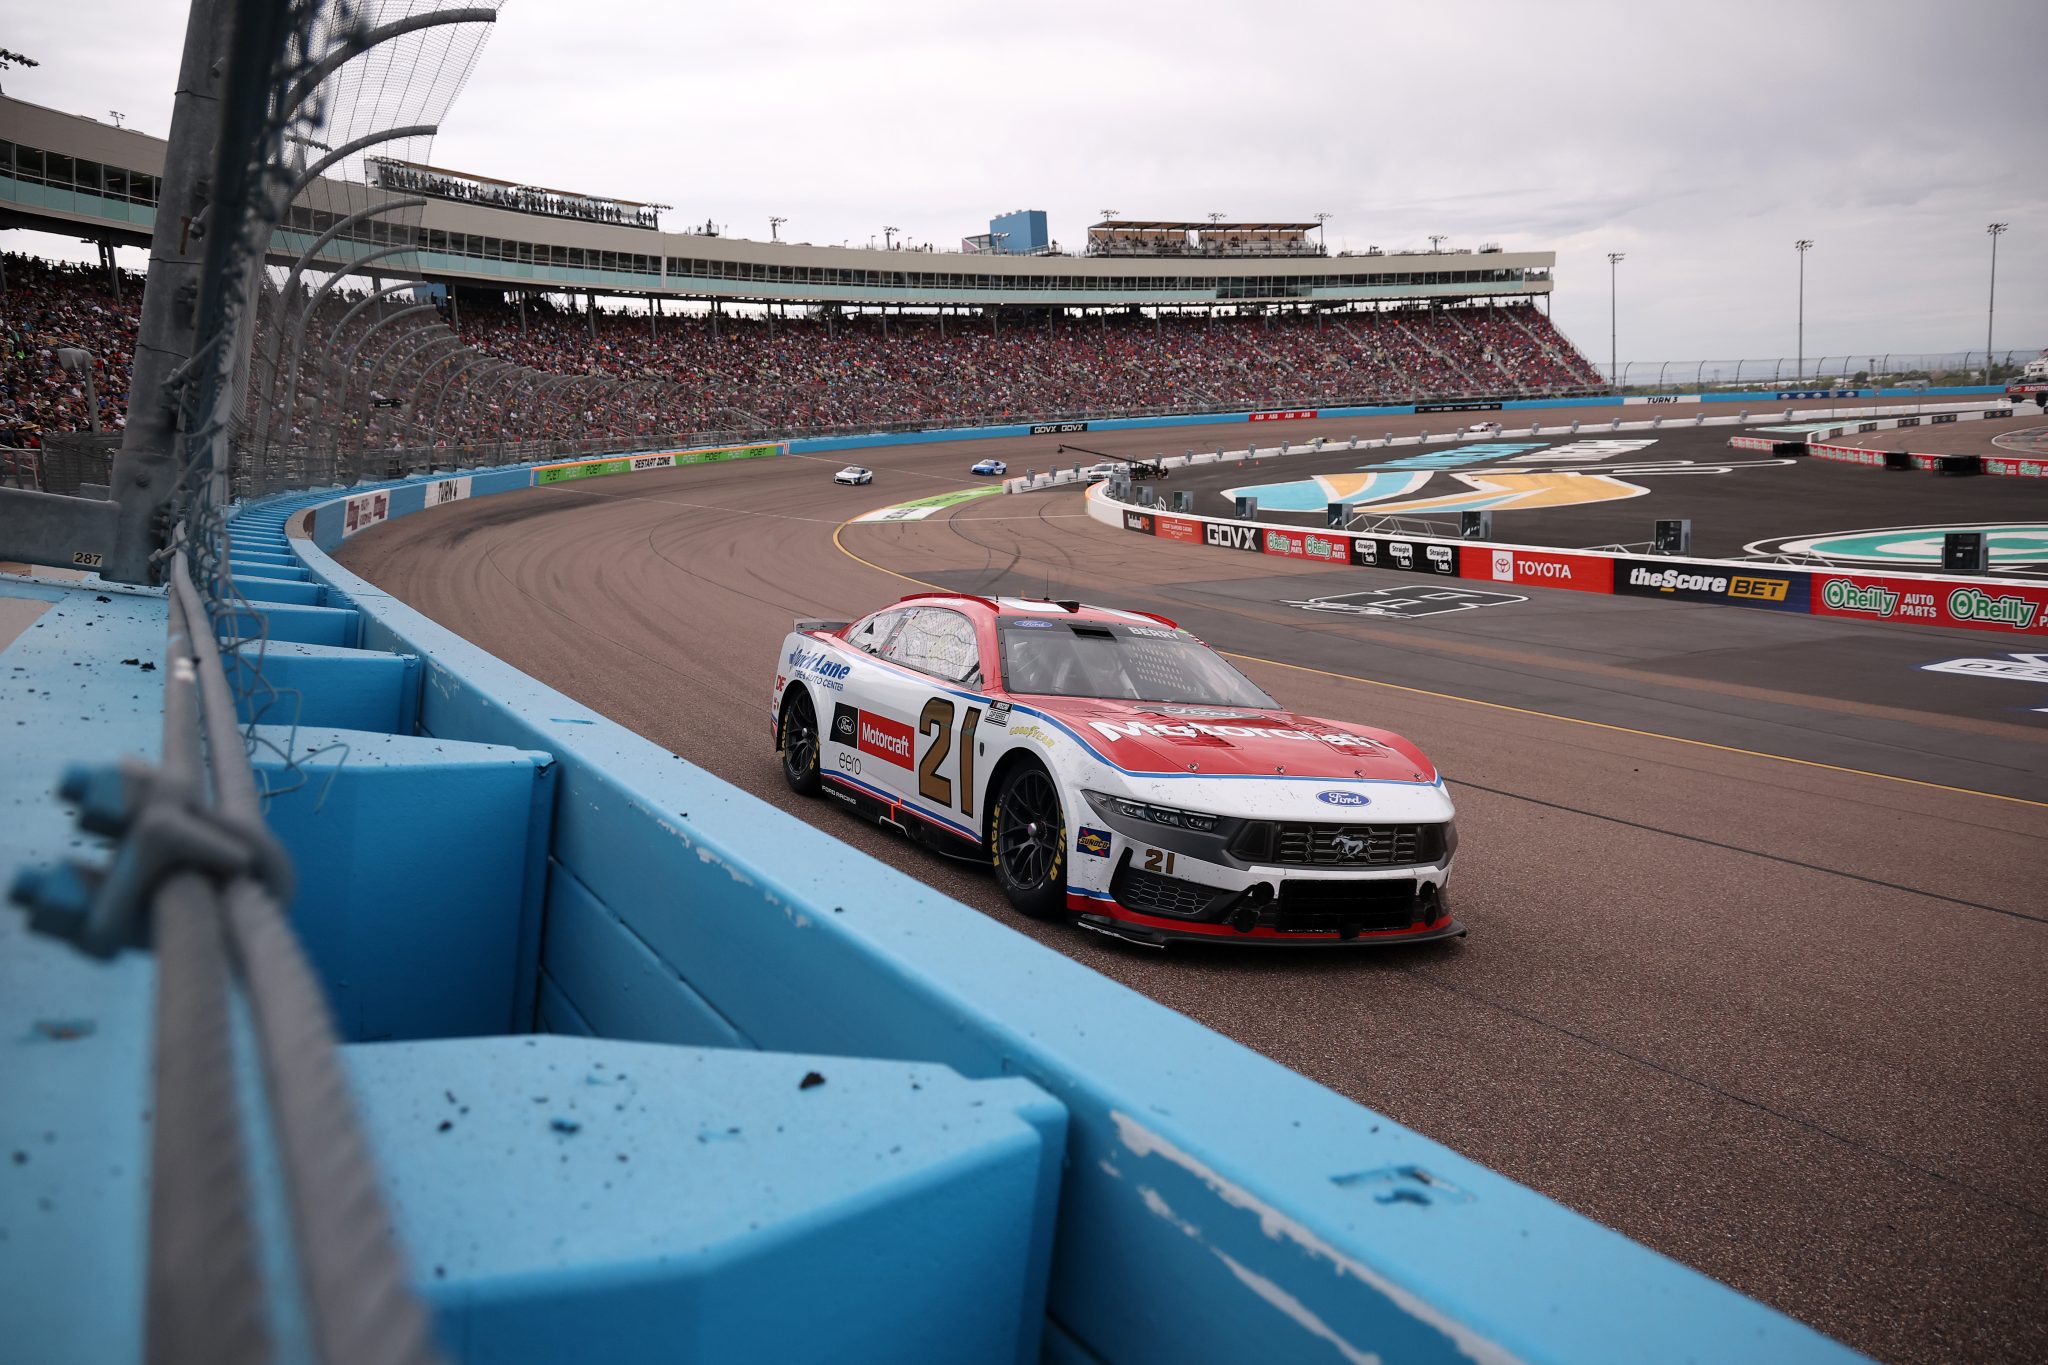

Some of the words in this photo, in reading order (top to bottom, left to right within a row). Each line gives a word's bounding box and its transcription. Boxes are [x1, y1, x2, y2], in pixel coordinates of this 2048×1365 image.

[1647, 396, 1671, 404] TURN
[1034, 425, 1057, 434] GOVX
[1061, 423, 1083, 432] GOVX
[704, 451, 722, 461] POET
[749, 447, 767, 457] POET
[634, 457, 655, 469] RESTART
[656, 455, 671, 467] ZONE
[546, 469, 561, 480] POET
[586, 464, 603, 475] POET
[438, 480, 453, 504] TURN
[1207, 523, 1257, 550] GOVX
[1266, 530, 1292, 553] O'Reilly
[1291, 539, 1302, 547] AUTO
[1290, 546, 1303, 555] PARTS
[1304, 535, 1333, 560] O'Reilly
[1333, 543, 1345, 552] AUTO
[1357, 541, 1375, 550] Straight
[1391, 544, 1411, 554] Straight
[1429, 547, 1450, 558] Straight
[74, 552, 102, 565] 287
[1332, 551, 1346, 560] PARTS
[1364, 553, 1375, 562] Talk
[1400, 557, 1411, 567] Talk
[1437, 561, 1450, 571] Talk
[1517, 560, 1572, 580] TOYOTA
[1629, 567, 1728, 592] theScore
[1733, 578, 1784, 598] BET
[1824, 580, 1899, 616] O'Reilly
[1903, 593, 1935, 606] AUTO
[1900, 604, 1938, 618] PARTS
[1948, 588, 2038, 629] O'Reilly
[1127, 626, 1181, 640] BERRY
[811, 654, 851, 680] Lane
[806, 674, 822, 685] AUTO
[822, 678, 844, 692] CENTER
[862, 722, 910, 758] Motorcraft
[1008, 725, 1055, 749] GOODYEAR
[838, 752, 861, 775] eero
[919, 696, 982, 818] 21
[821, 785, 836, 796] FORD
[835, 791, 857, 805] RACING
[1328, 792, 1362, 805] Ford
[991, 804, 1001, 867] EAGLE
[1079, 836, 1109, 849] SUNOCO
[1144, 848, 1175, 875] 21
